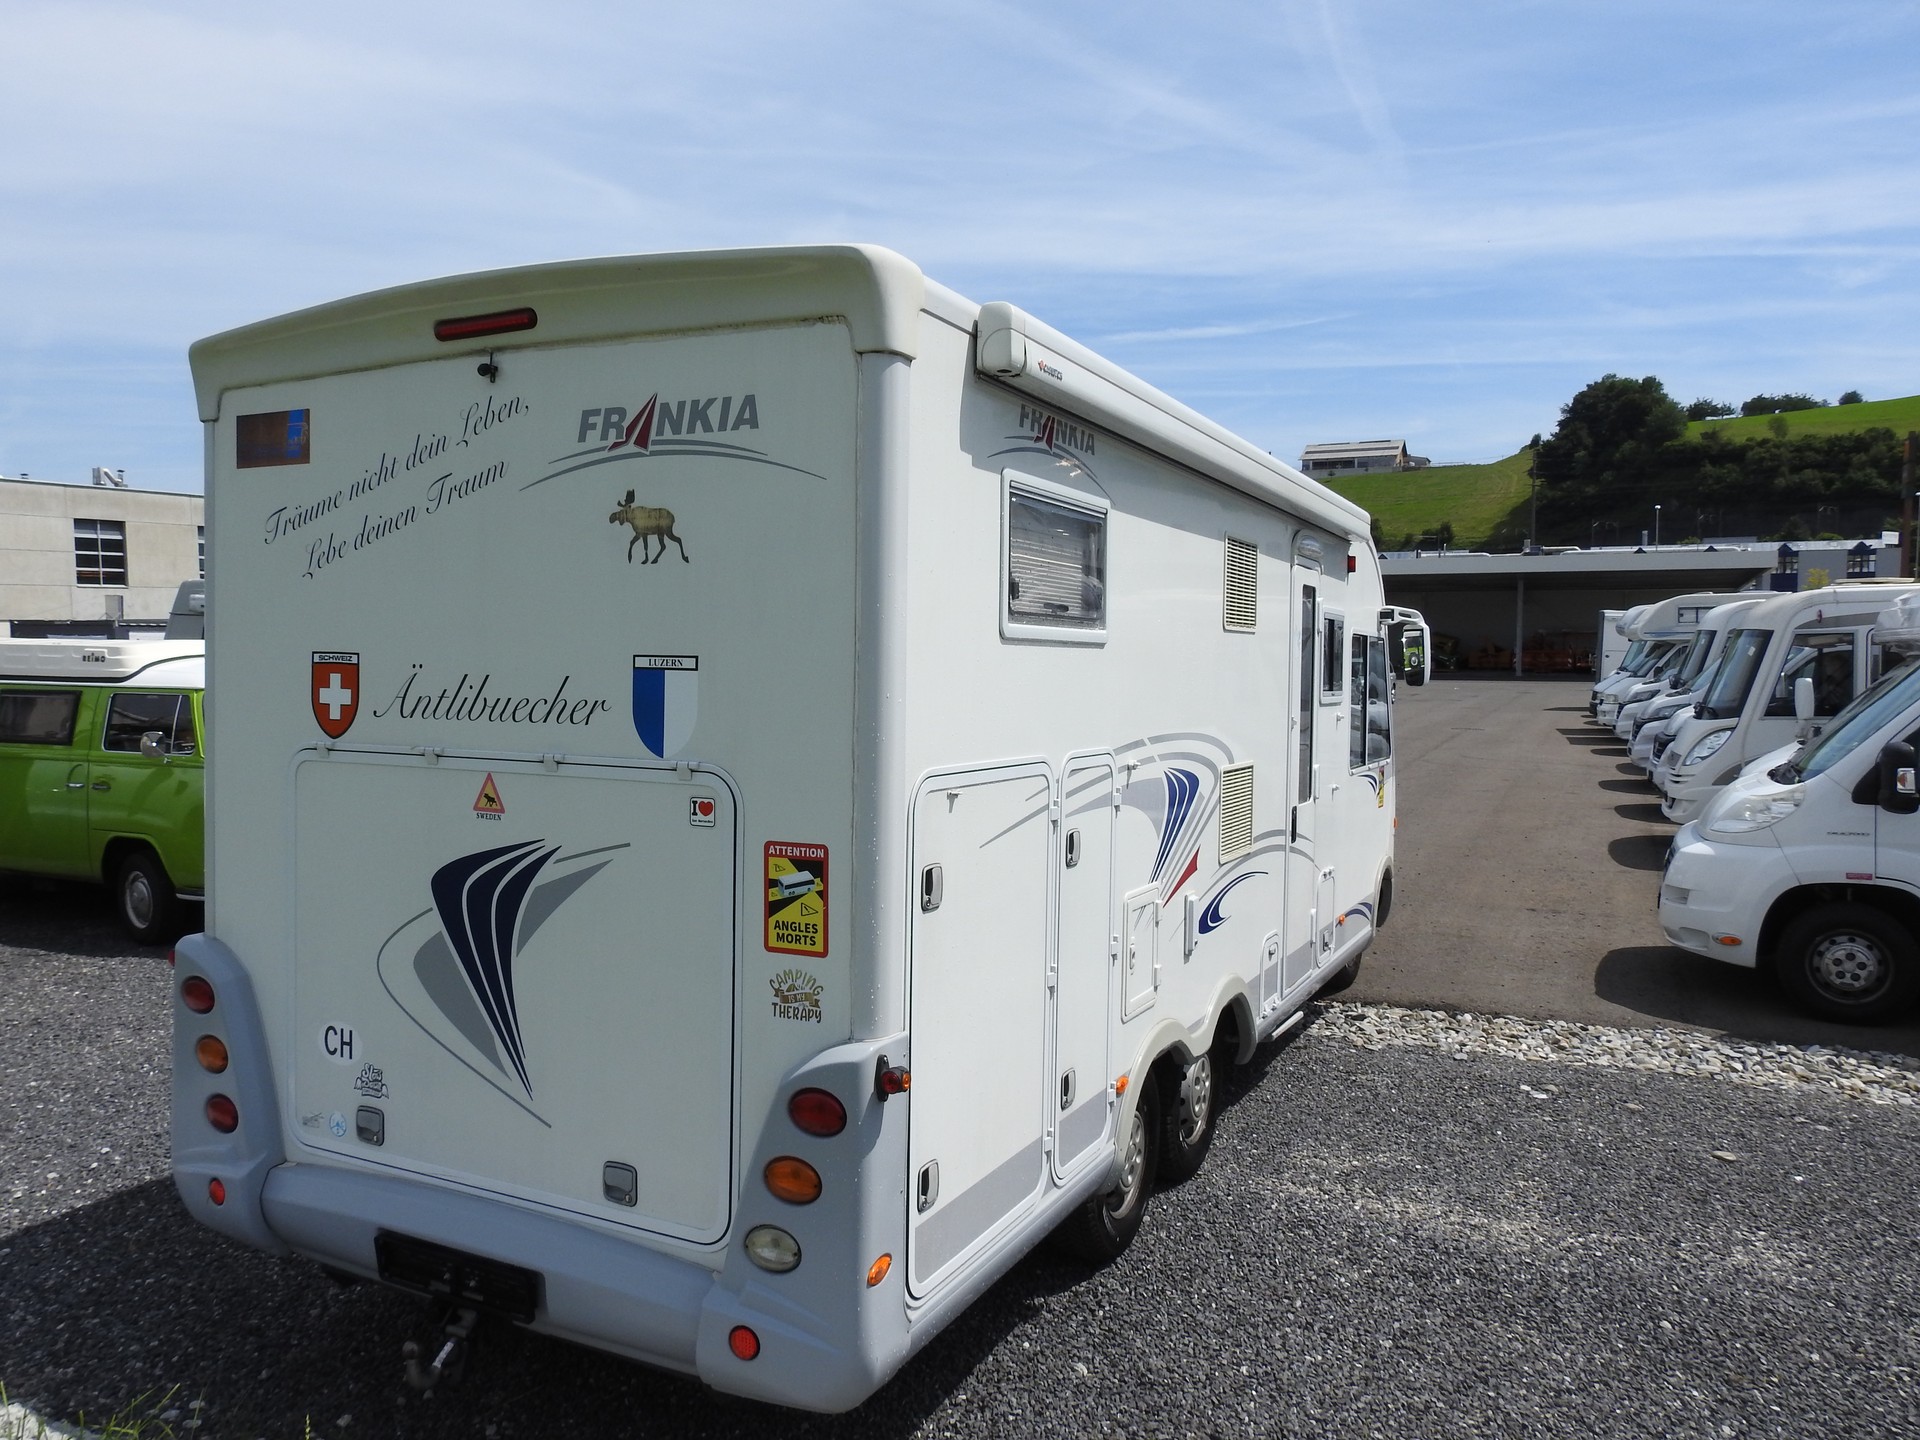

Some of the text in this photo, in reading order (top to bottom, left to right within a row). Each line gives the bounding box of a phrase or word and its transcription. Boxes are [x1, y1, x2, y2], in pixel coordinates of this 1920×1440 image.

[577, 392, 760, 454] FRANKIA
[1018, 402, 1096, 456] FRANKIA
[264, 395, 529, 545] Träume nicht dein Leben,
[302, 460, 510, 580] Lebe deinen Traum
[318, 654, 353, 662] SCHWEIZ
[648, 658, 684, 667] LUZERN
[373, 662, 612, 727] Äntlibuecher
[476, 812, 502, 820] SWEDEN
[691, 800, 698, 816] I
[768, 845, 825, 858] ATTENTION
[773, 920, 818, 935] ANGLES
[776, 932, 817, 947] MORTS
[769, 968, 824, 997] CAMPING
[771, 1002, 822, 1024] THERAPY
[324, 1025, 353, 1060] CH
